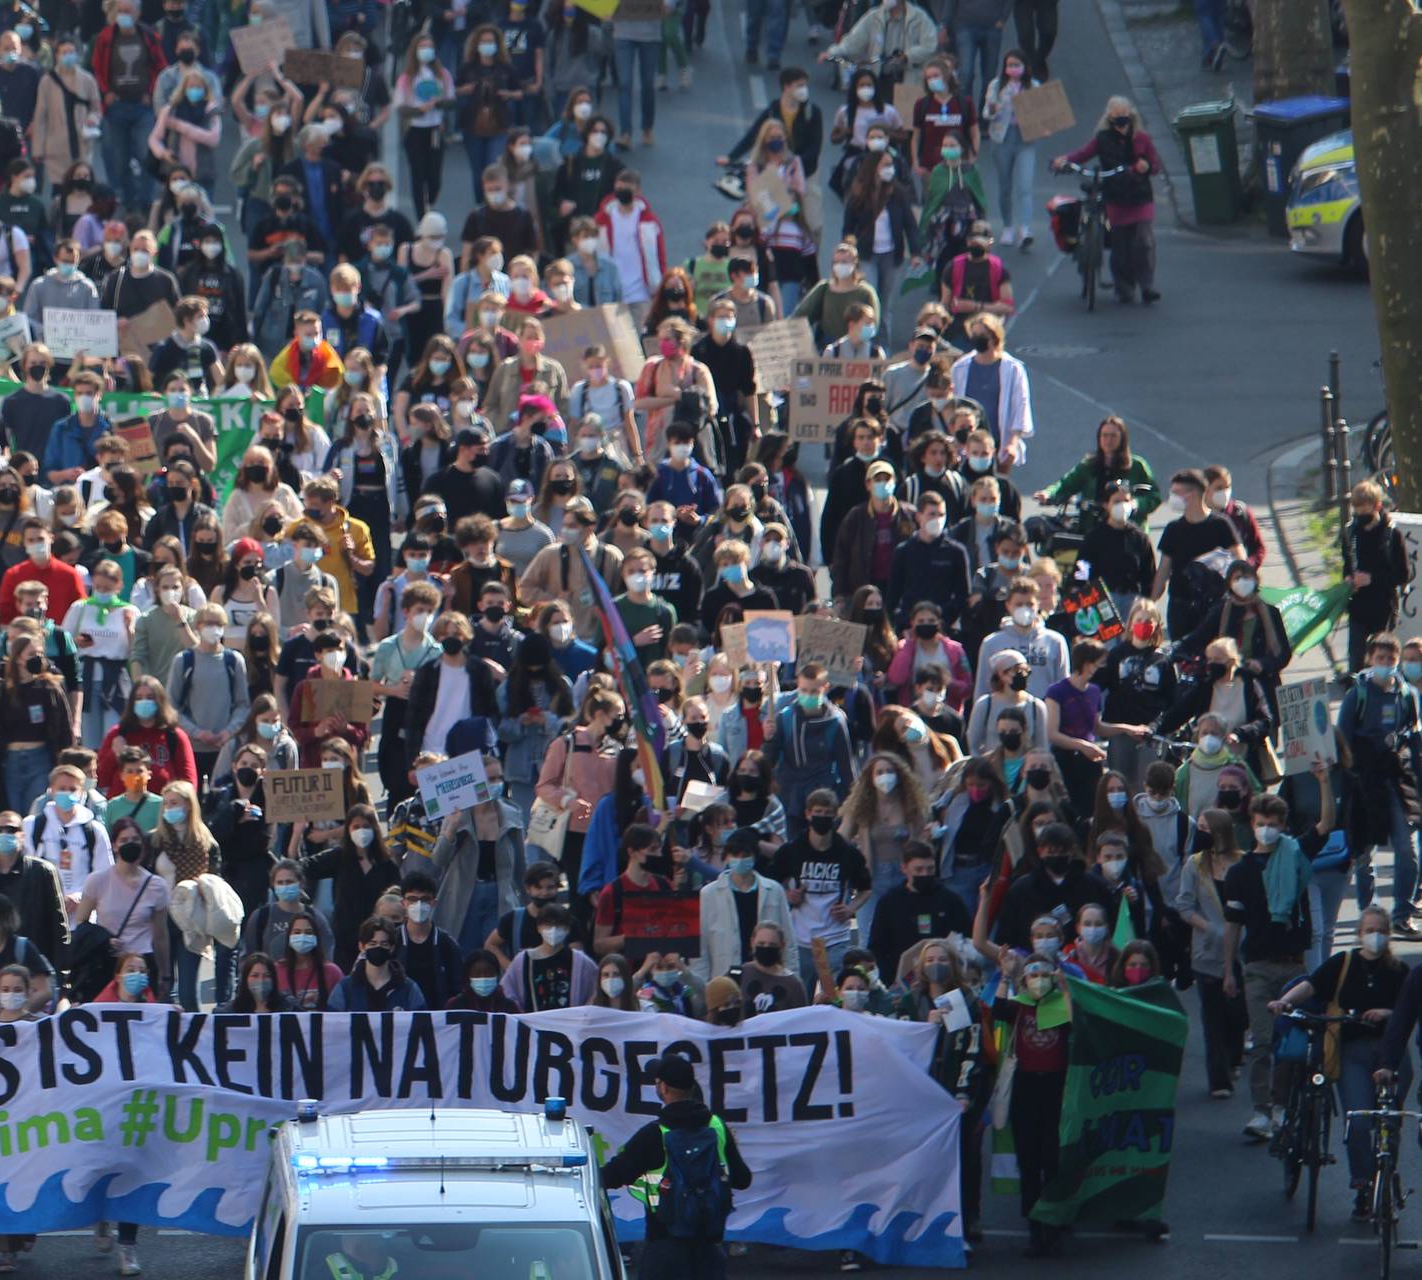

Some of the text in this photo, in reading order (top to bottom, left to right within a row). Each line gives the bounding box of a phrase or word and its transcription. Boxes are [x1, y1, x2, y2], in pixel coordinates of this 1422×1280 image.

[272, 775, 320, 795] FUTUR
[37, 1008, 145, 1090] IST
[166, 1010, 324, 1100] KEIN
